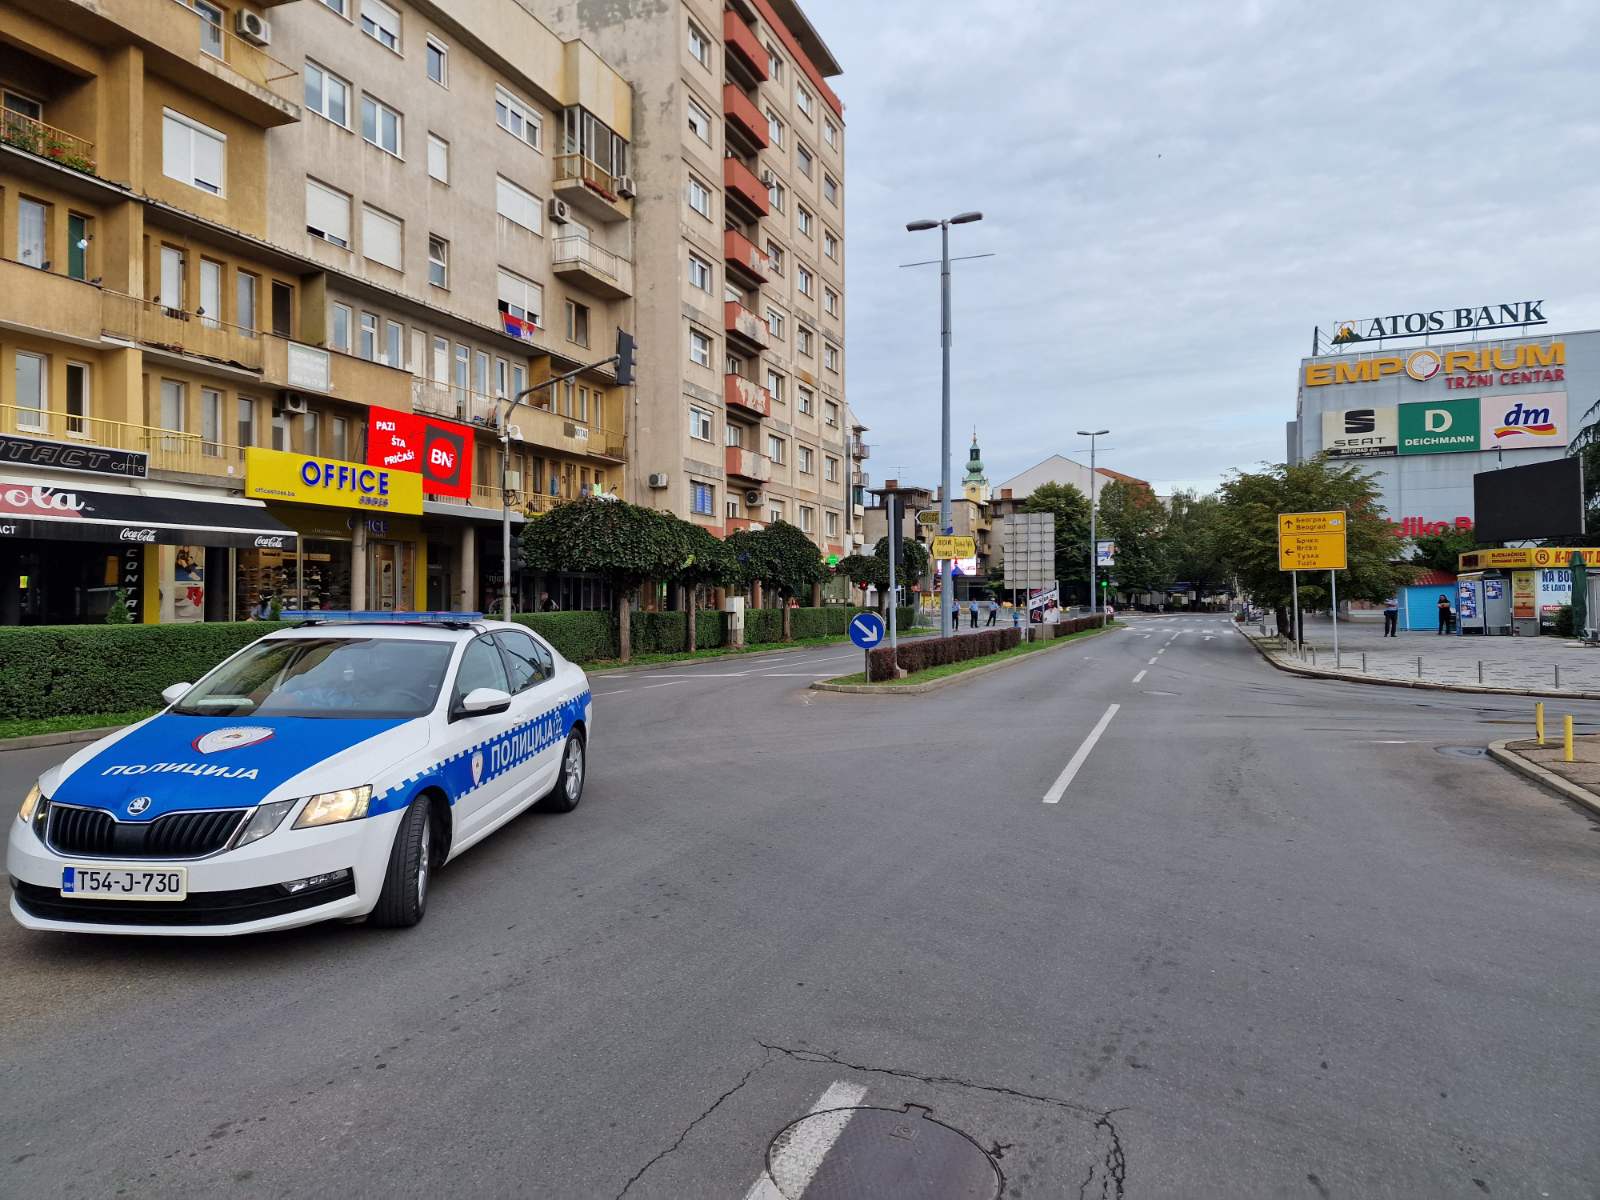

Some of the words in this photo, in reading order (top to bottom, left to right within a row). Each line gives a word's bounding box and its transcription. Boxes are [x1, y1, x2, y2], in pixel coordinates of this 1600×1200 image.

[1367, 310, 1444, 337] ATOS
[1454, 299, 1546, 328] BANK
[1305, 342, 1567, 387] EMPORIUM
[1446, 371, 1493, 389] TRŽNI
[1499, 368, 1565, 385] CENTAR
[1504, 403, 1550, 426] dm
[376, 421, 396, 432] PAZI
[391, 435, 406, 448] ŠTA
[1334, 436, 1386, 447] SEAT
[1405, 435, 1475, 447] DEICHMANN
[0, 440, 110, 468] TACT
[110, 453, 145, 476] caffe
[384, 449, 415, 466] PRIČAŠ!
[301, 460, 389, 496] OFFICE
[0, 486, 85, 511] ola
[120, 527, 158, 542] Coca-Cola
[254, 535, 284, 548] Coca-Cola
[1557, 570, 1573, 583] BO
[1542, 584, 1549, 592] SE
[491, 718, 553, 773] ПОЛИЦИЈА
[101, 762, 259, 780] ПОЛИЦИЈА
[77, 870, 180, 893] T54-J-730
